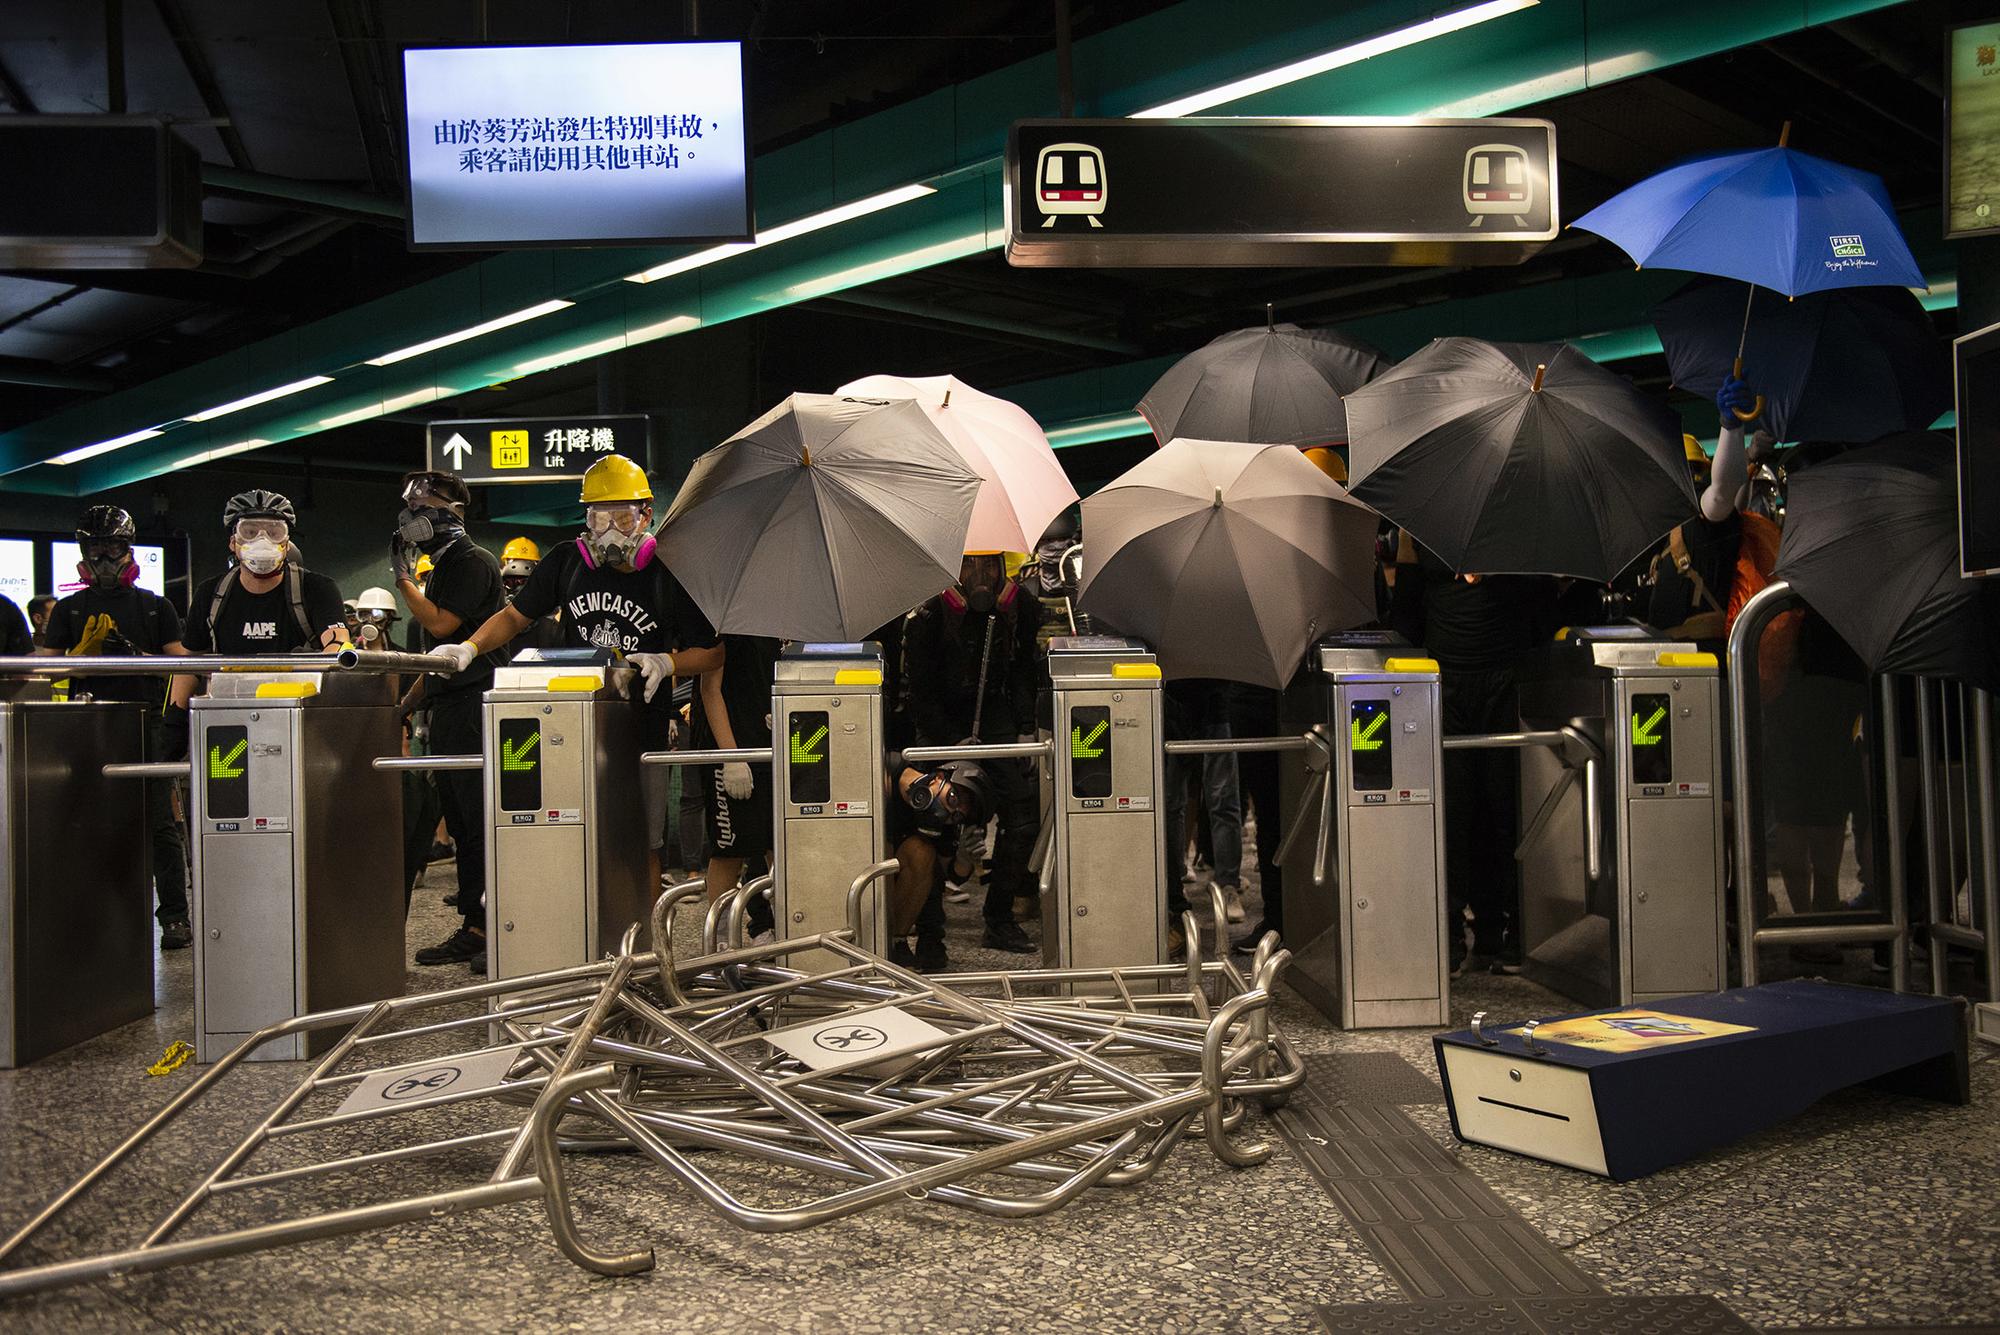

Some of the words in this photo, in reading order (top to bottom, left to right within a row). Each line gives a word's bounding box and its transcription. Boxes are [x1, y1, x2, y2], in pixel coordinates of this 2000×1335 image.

[433, 113, 719, 145] 由於葵芳站發生特別事故，
[459, 143, 696, 174] 乘客請使用其他車站。
[1833, 238, 1858, 246] FIRST
[1836, 246, 1863, 255] CHOICE
[544, 427, 615, 454] 升降機
[545, 456, 565, 467] Lift
[568, 591, 658, 635] NEWCASTLE
[242, 622, 276, 636] AAPE
[577, 625, 588, 641] 18
[622, 635, 639, 651] 92
[714, 769, 736, 849] Lutheran
